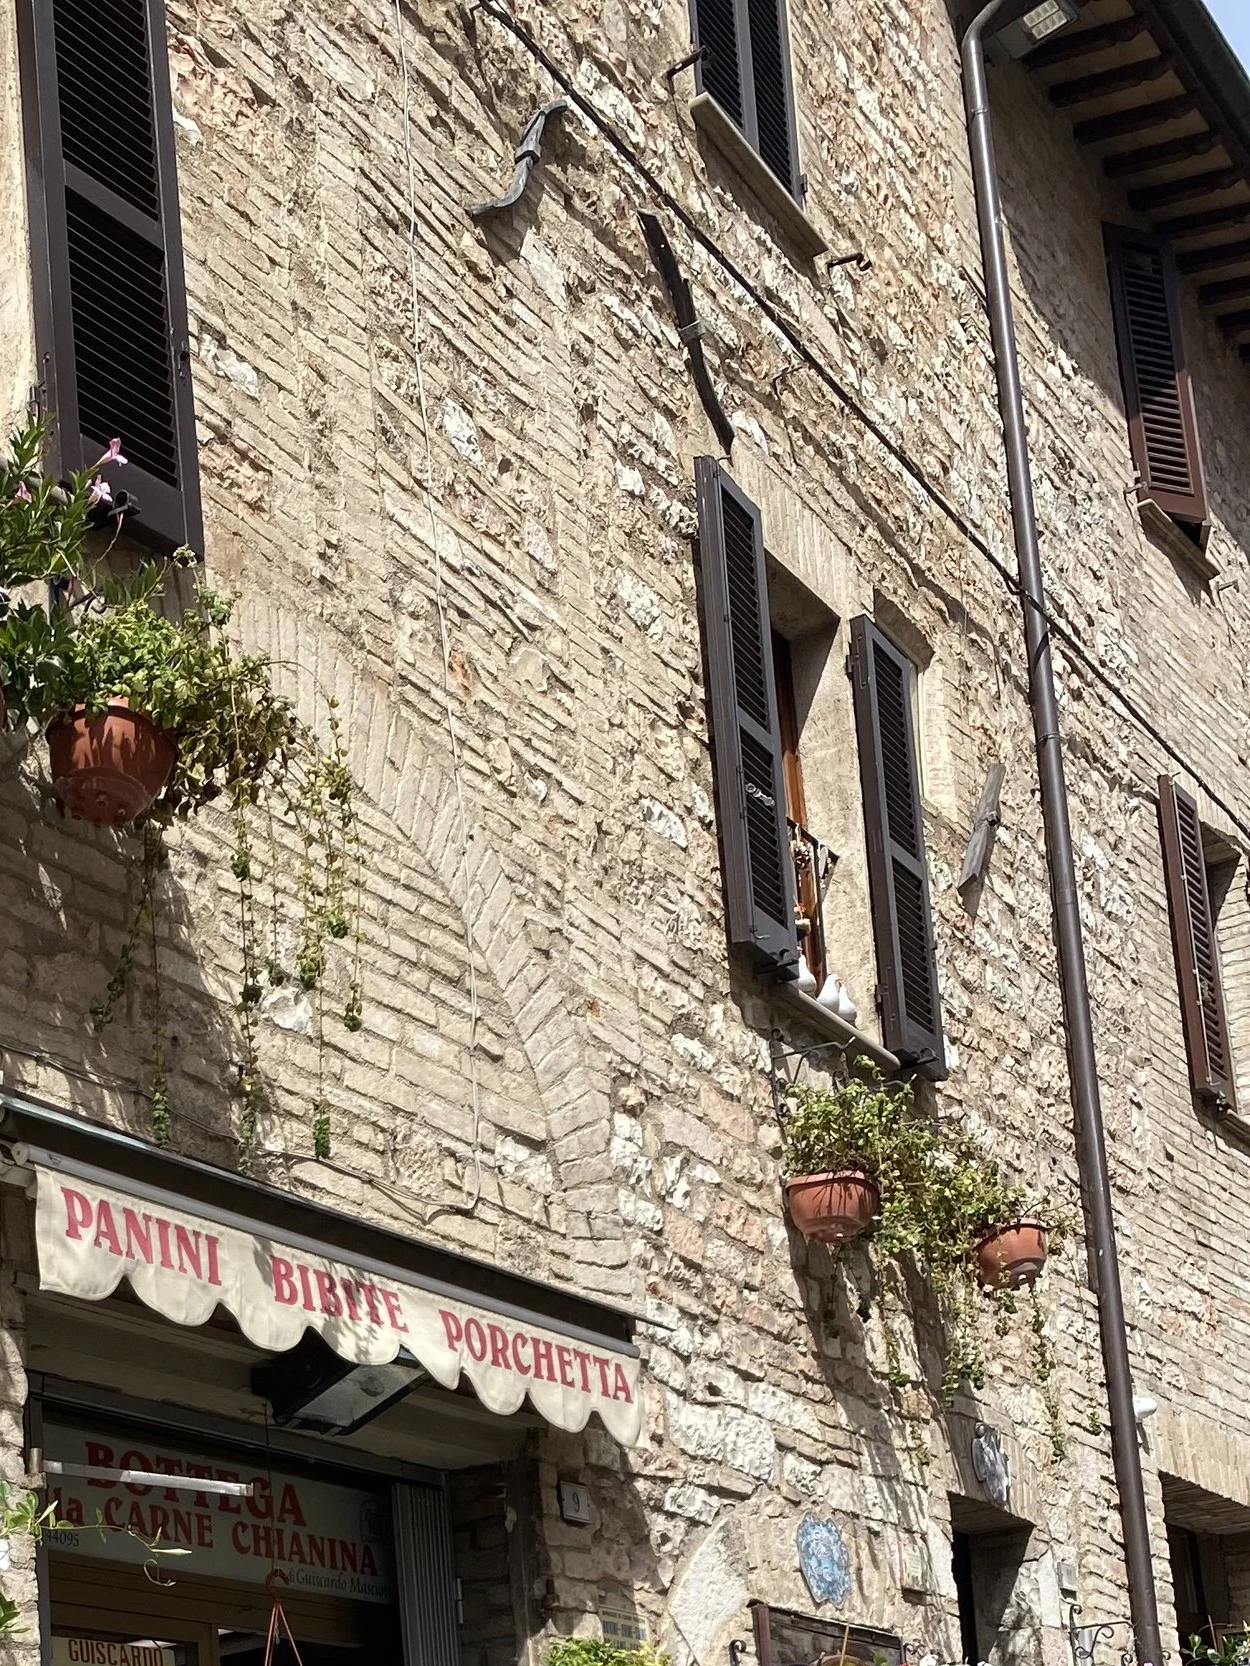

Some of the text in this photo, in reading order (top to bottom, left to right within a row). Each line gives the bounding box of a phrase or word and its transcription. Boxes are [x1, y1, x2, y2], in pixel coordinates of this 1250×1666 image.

[60, 1186, 635, 1404] PANINI BIBITE PORCHETTA
[85, 1441, 307, 1527] BOTTEGA
[572, 1491, 580, 1514] 9
[104, 1497, 214, 1548] CARNE
[232, 1521, 380, 1577] CHIANINA
[296, 1567, 348, 1592] Guiscardo
